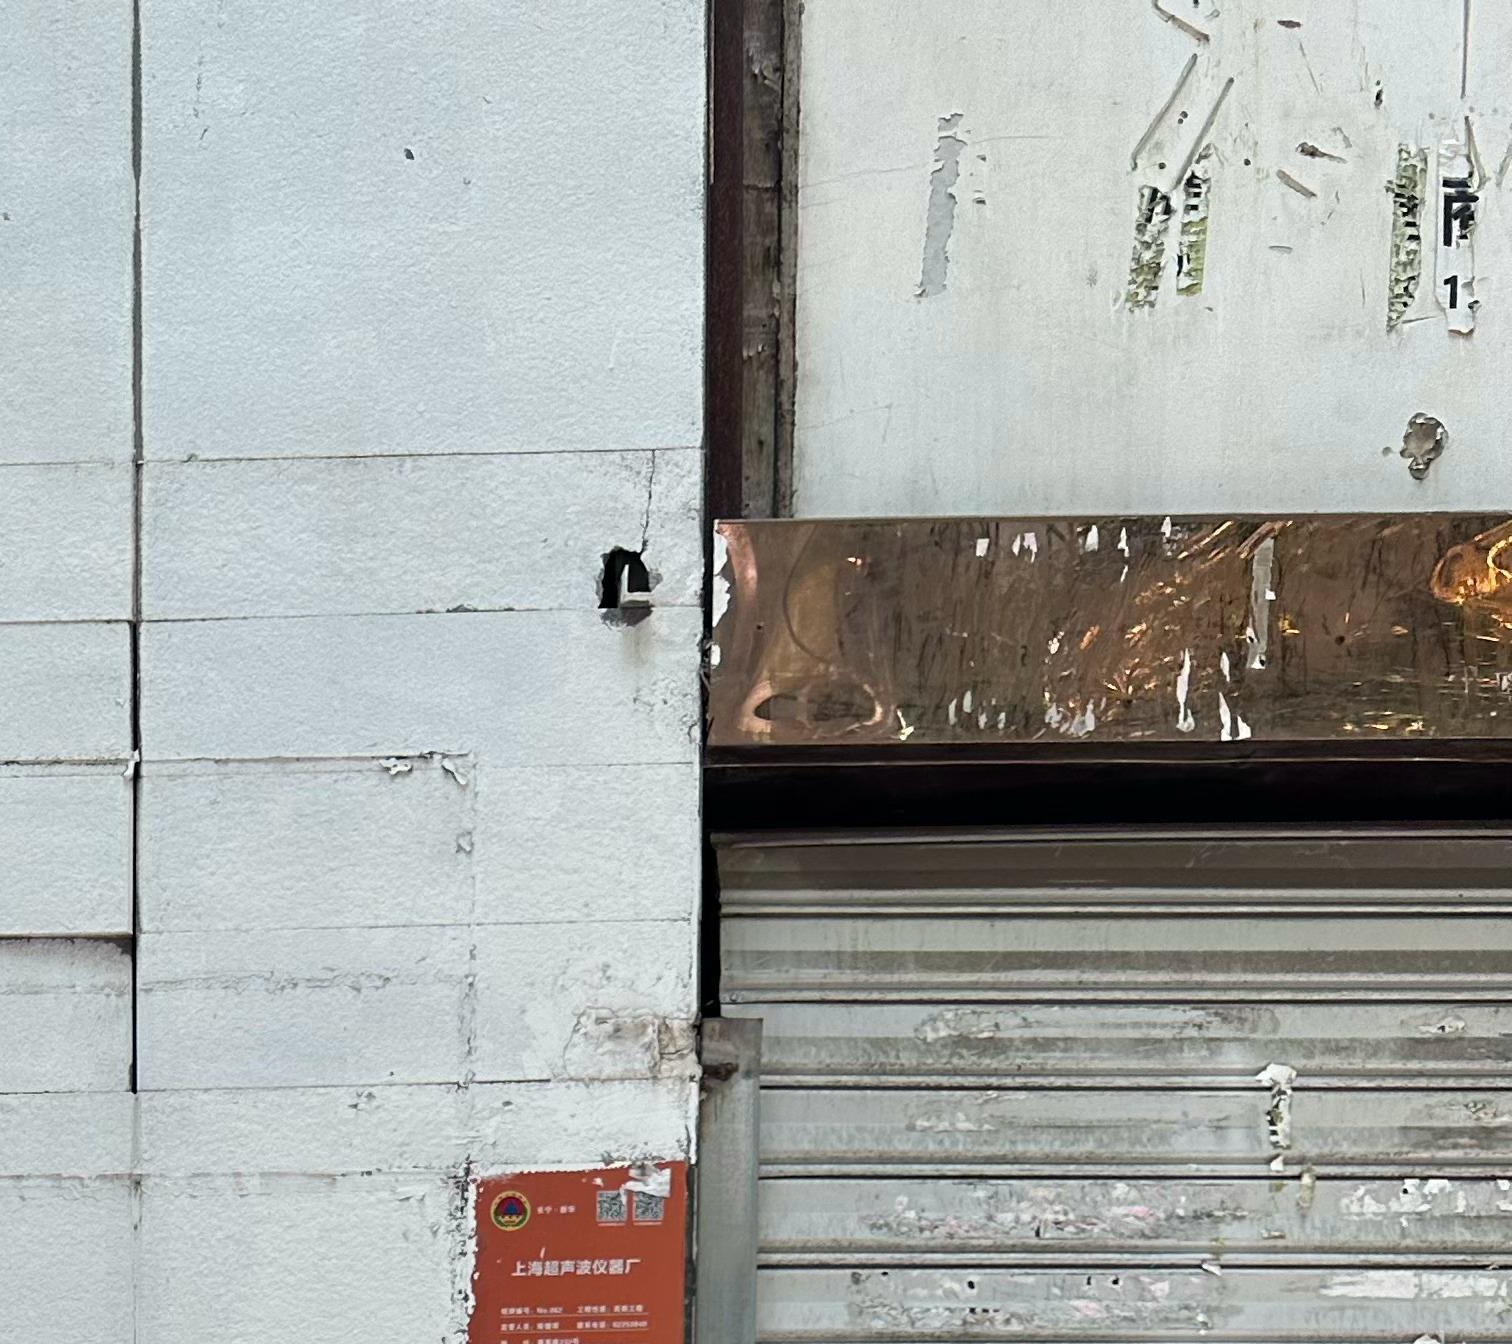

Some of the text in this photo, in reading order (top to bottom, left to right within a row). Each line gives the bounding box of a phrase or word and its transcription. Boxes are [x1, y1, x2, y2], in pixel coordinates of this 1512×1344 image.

[511, 1259, 641, 1276] 上海超声波仪器厂
